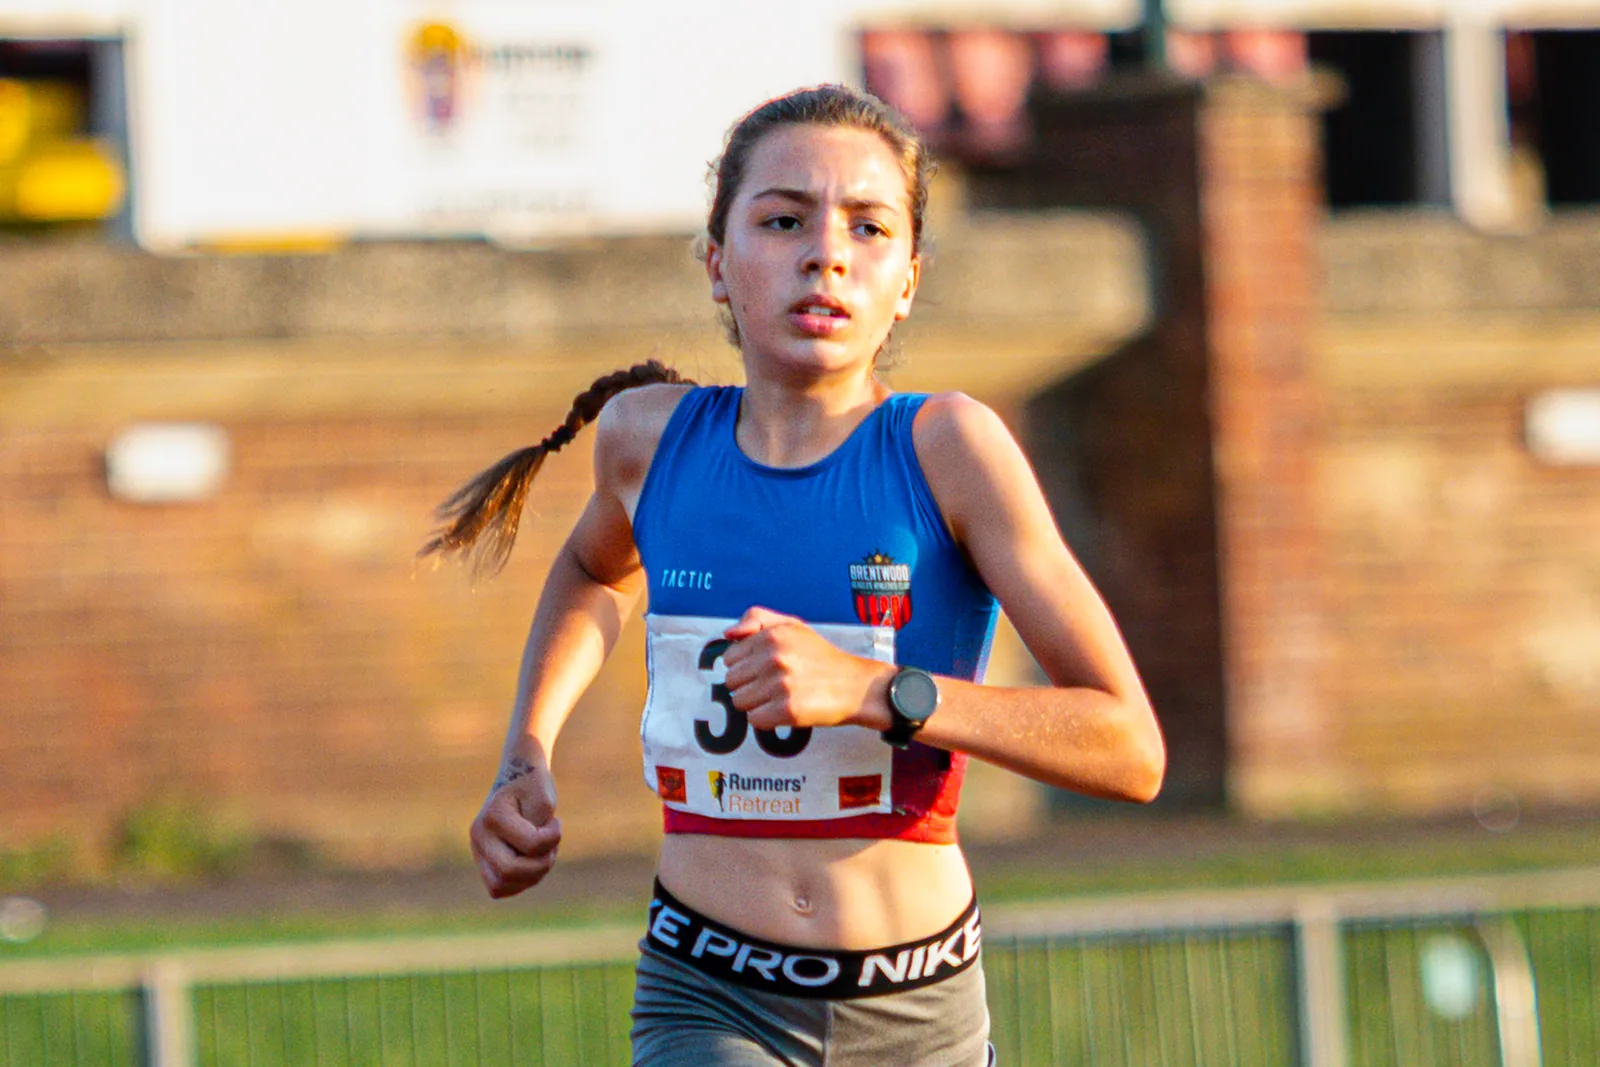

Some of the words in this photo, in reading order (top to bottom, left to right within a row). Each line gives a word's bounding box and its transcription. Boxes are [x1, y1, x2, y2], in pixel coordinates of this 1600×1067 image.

[661, 569, 713, 591] TACTIC
[850, 564, 910, 581] BRENTWOOD
[729, 773, 807, 791] Runners'
[728, 795, 801, 814] Retreat
[691, 926, 841, 987] PRO
[857, 905, 981, 987] NIKE
